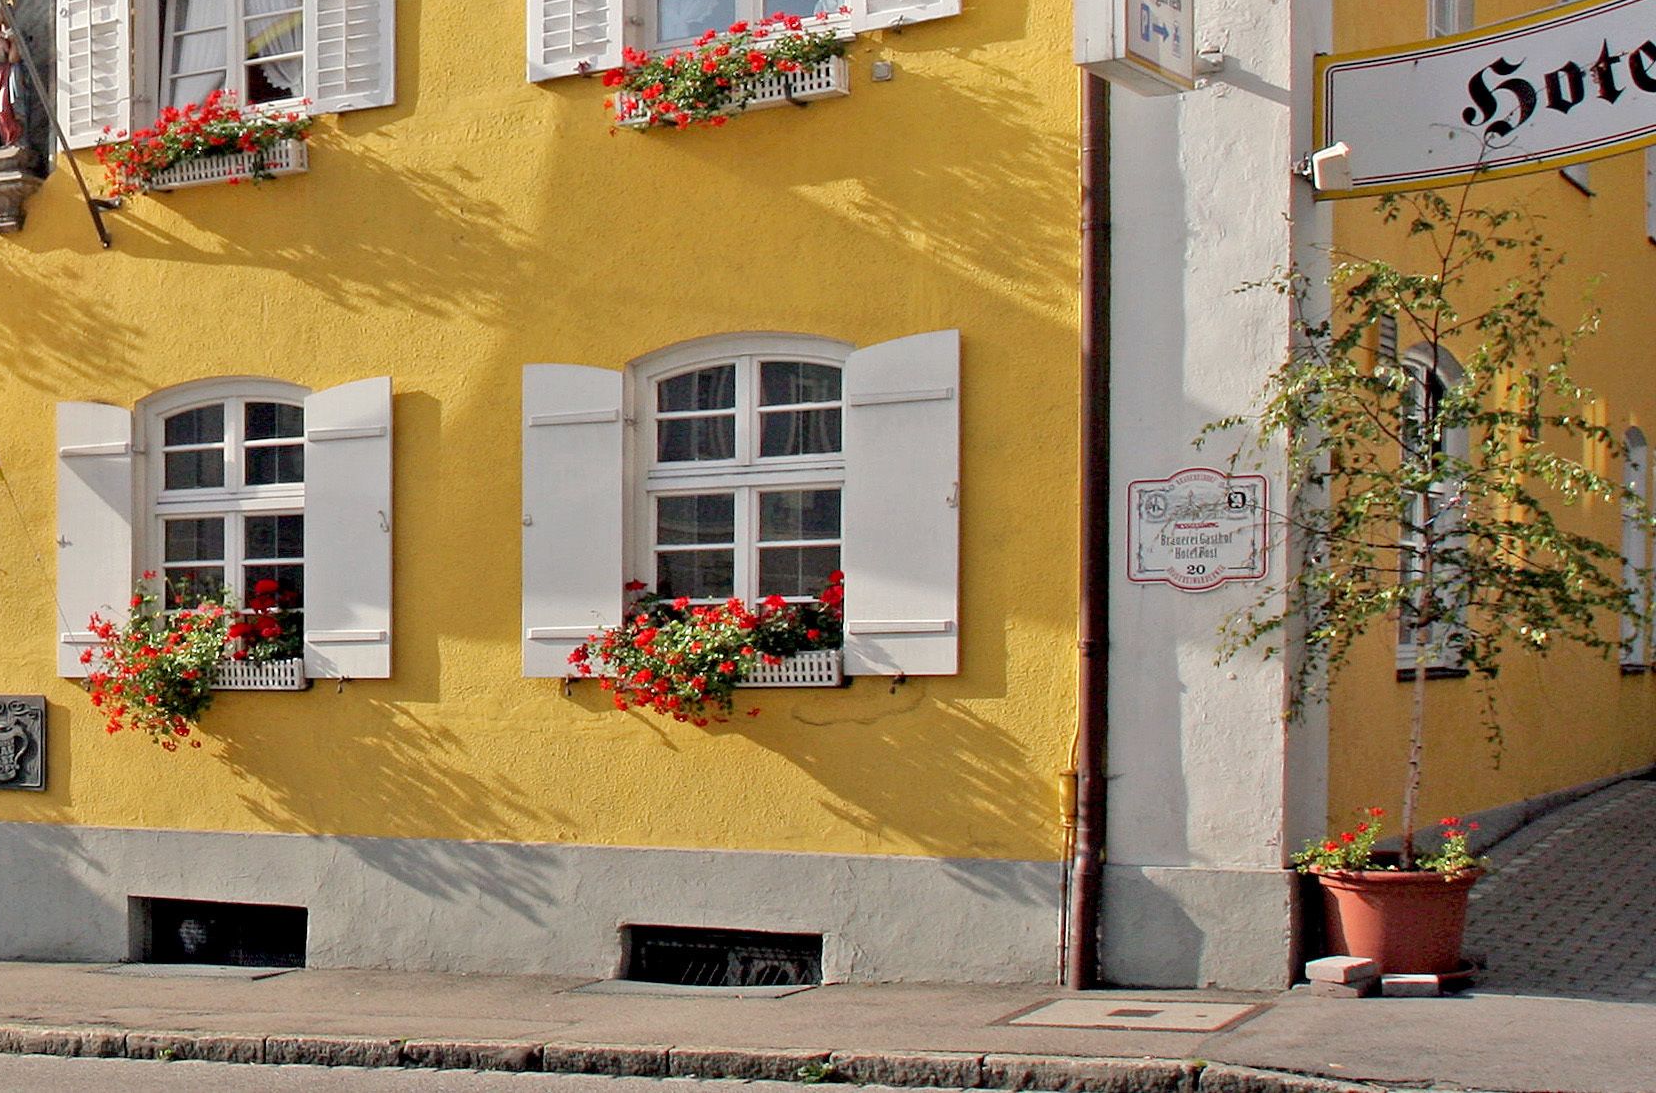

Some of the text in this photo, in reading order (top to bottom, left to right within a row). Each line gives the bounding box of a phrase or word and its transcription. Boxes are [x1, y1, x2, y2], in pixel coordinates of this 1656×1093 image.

[1199, 531, 1233, 545] Gasthof
[1175, 547, 1218, 560] Hotel Post
[1187, 565, 1205, 575] 20
